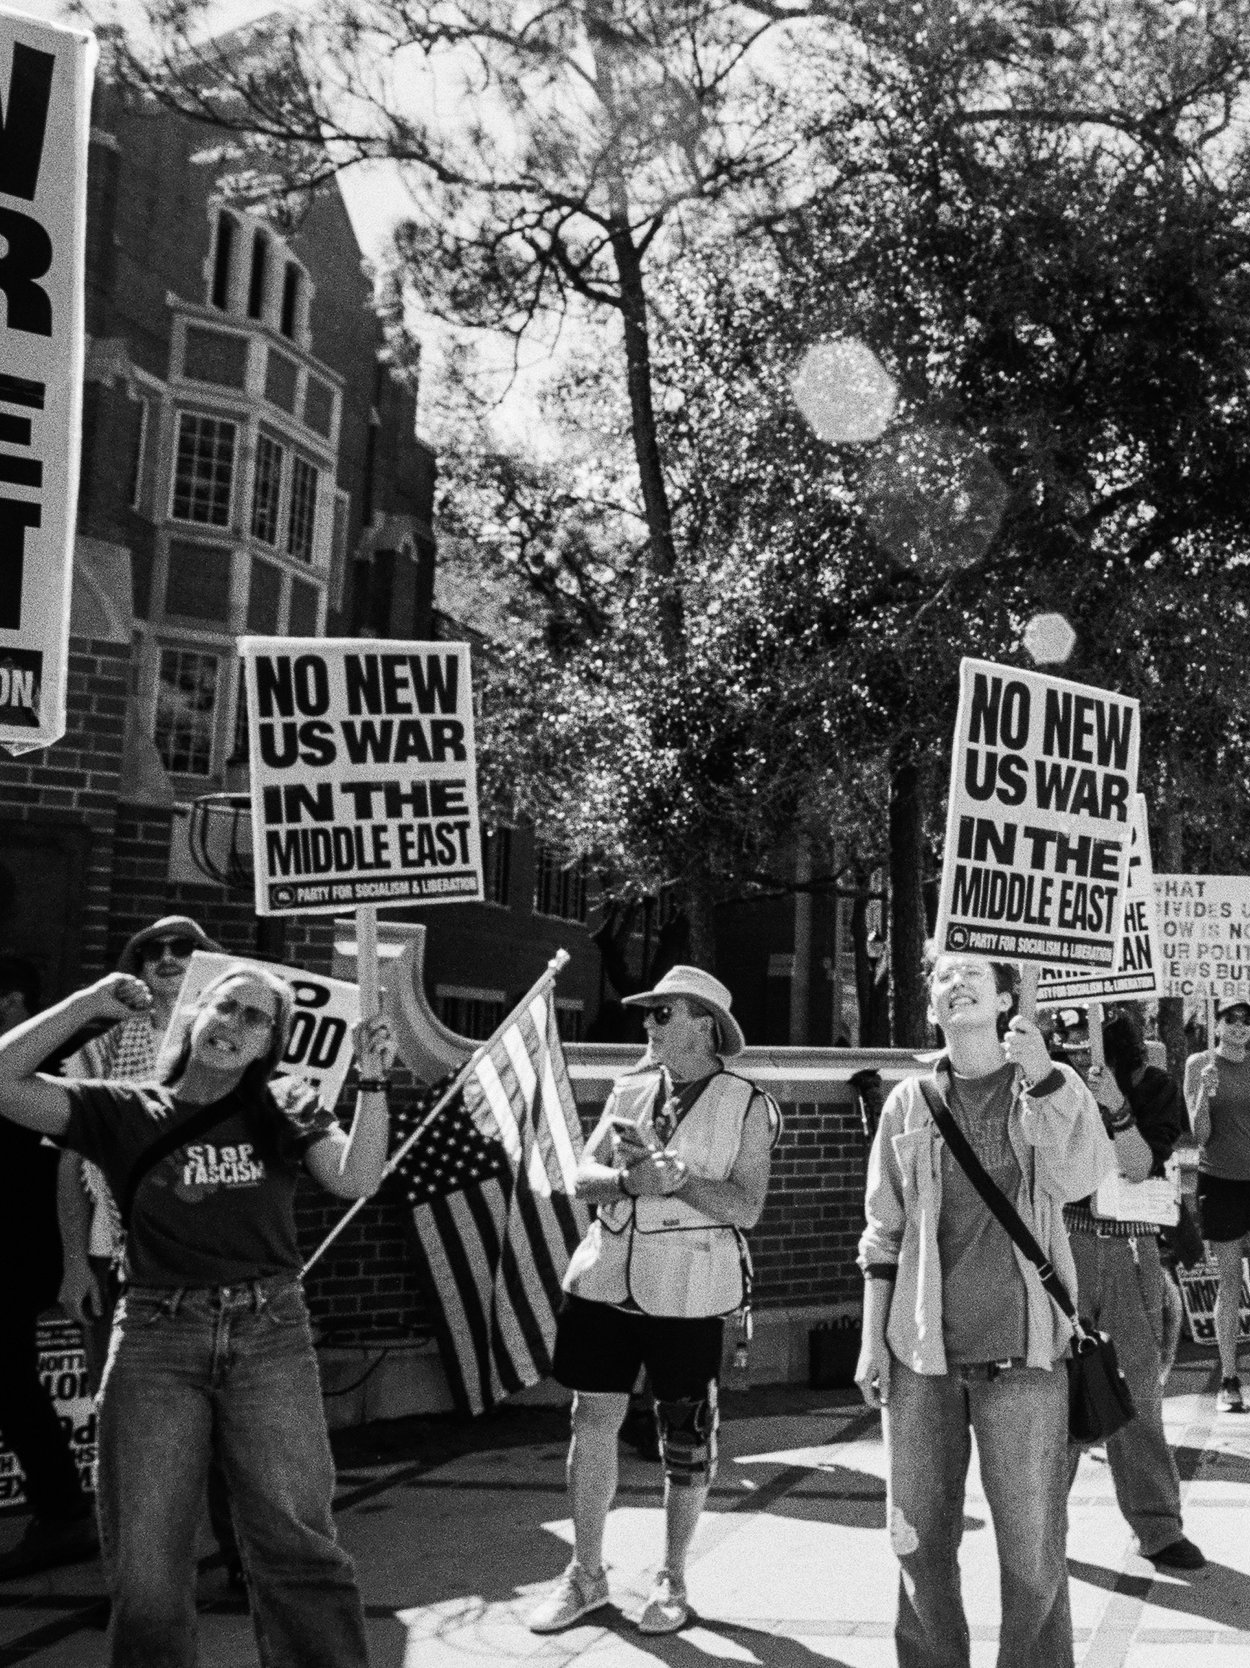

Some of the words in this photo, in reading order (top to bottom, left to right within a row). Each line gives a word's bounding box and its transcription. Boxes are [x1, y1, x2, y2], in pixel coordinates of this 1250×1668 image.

[255, 654, 330, 717] NO
[344, 653, 459, 715] NEW
[259, 720, 337, 768] US
[340, 719, 467, 764] WAR
[968, 672, 1031, 751] NO
[1042, 688, 1133, 771] NEW
[263, 783, 335, 824] IN
[340, 779, 469, 820] THE
[964, 748, 1029, 806] US
[1034, 759, 1129, 823] WAR
[265, 824, 391, 877] MIDDLE
[398, 821, 470, 868] EAST
[957, 815, 1018, 866] IN
[1024, 826, 1122, 882] THE
[951, 864, 1052, 926] MIDDLE
[1057, 880, 1119, 934] EAST
[1125, 902, 1148, 933] HE
